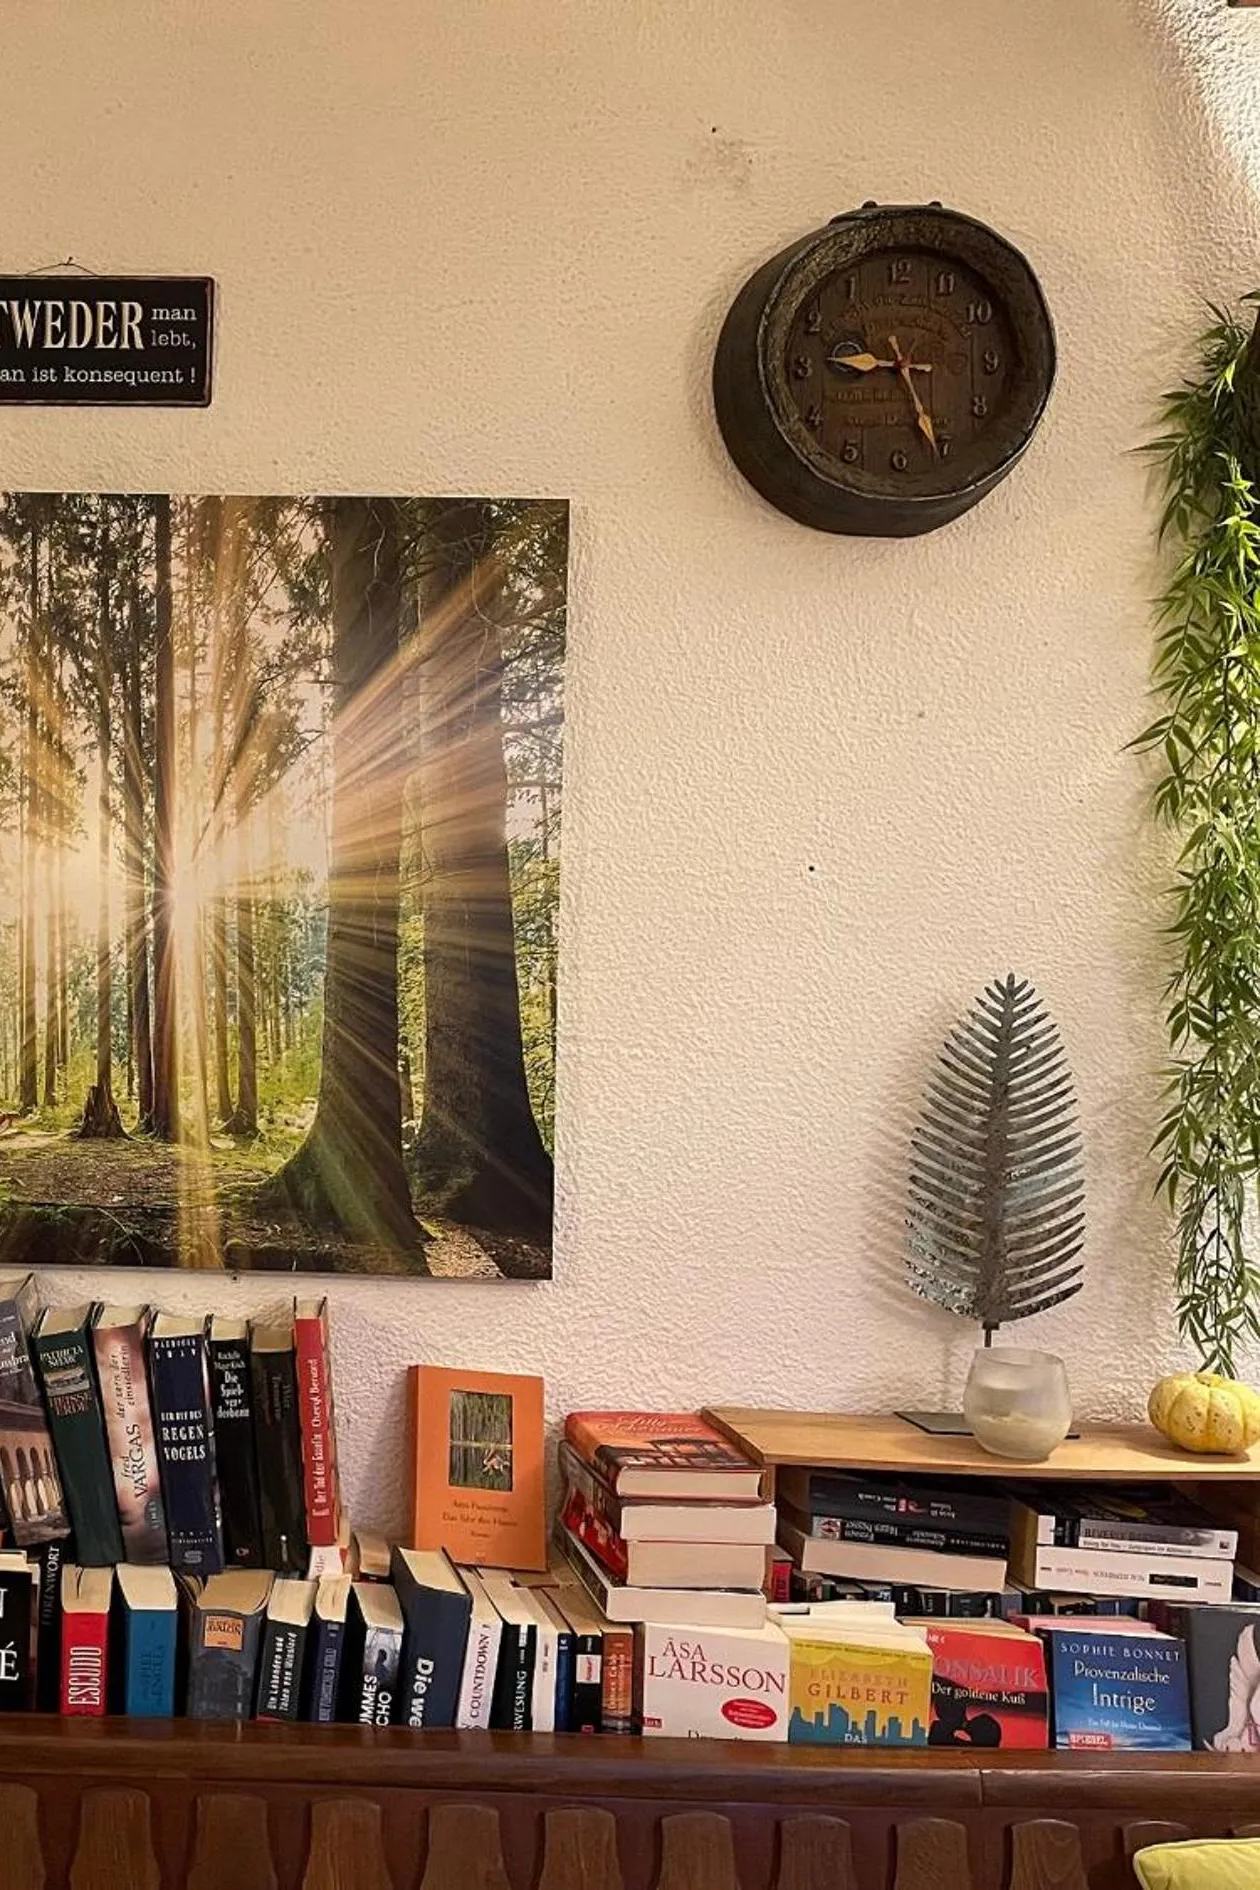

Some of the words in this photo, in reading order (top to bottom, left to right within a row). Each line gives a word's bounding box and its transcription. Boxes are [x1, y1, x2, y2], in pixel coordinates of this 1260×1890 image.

[890, 259, 911, 285] 12
[937, 272, 956, 294] 11
[846, 277, 857, 300] 1
[151, 307, 196, 321] man
[807, 311, 822, 333] 2
[966, 301, 991, 322] 10
[151, 330, 196, 349] lebt,
[984, 351, 999, 373] 9
[32, 366, 57, 382] ist
[64, 366, 183, 386] konsequent
[190, 367, 195, 383] !
[973, 396, 988, 417] 8
[843, 440, 858, 462] 5
[892, 451, 907, 470] 6
[224, 1371, 239, 1383] Die
[116, 1402, 126, 1419] der
[162, 1424, 204, 1441] REGEN
[126, 1423, 148, 1498] VARGAS
[164, 1444, 206, 1461] VOGELS
[120, 1456, 131, 1478] fred
[662, 1637, 708, 1662] ÅSA
[1060, 1642, 1116, 1658] SOPHIE
[1123, 1646, 1181, 1662] BONNET
[68, 1646, 102, 1706] ESCUDO
[413, 1657, 434, 1695] Die
[470, 1633, 490, 1719] COUNTDOWN
[648, 1655, 786, 1694] LARSSON
[934, 1656, 1039, 1688] ONSALIK
[1074, 1660, 1170, 1685] Provenzalische
[807, 1682, 909, 1705] GILBERT
[932, 1681, 954, 1696] Der
[955, 1686, 999, 1700] goldene
[1002, 1691, 1026, 1705] Kuß
[1092, 1683, 1156, 1714] Intrige
[375, 1691, 392, 1727] CHO
[408, 1698, 425, 1728] we
[844, 1733, 868, 1743] DAS
